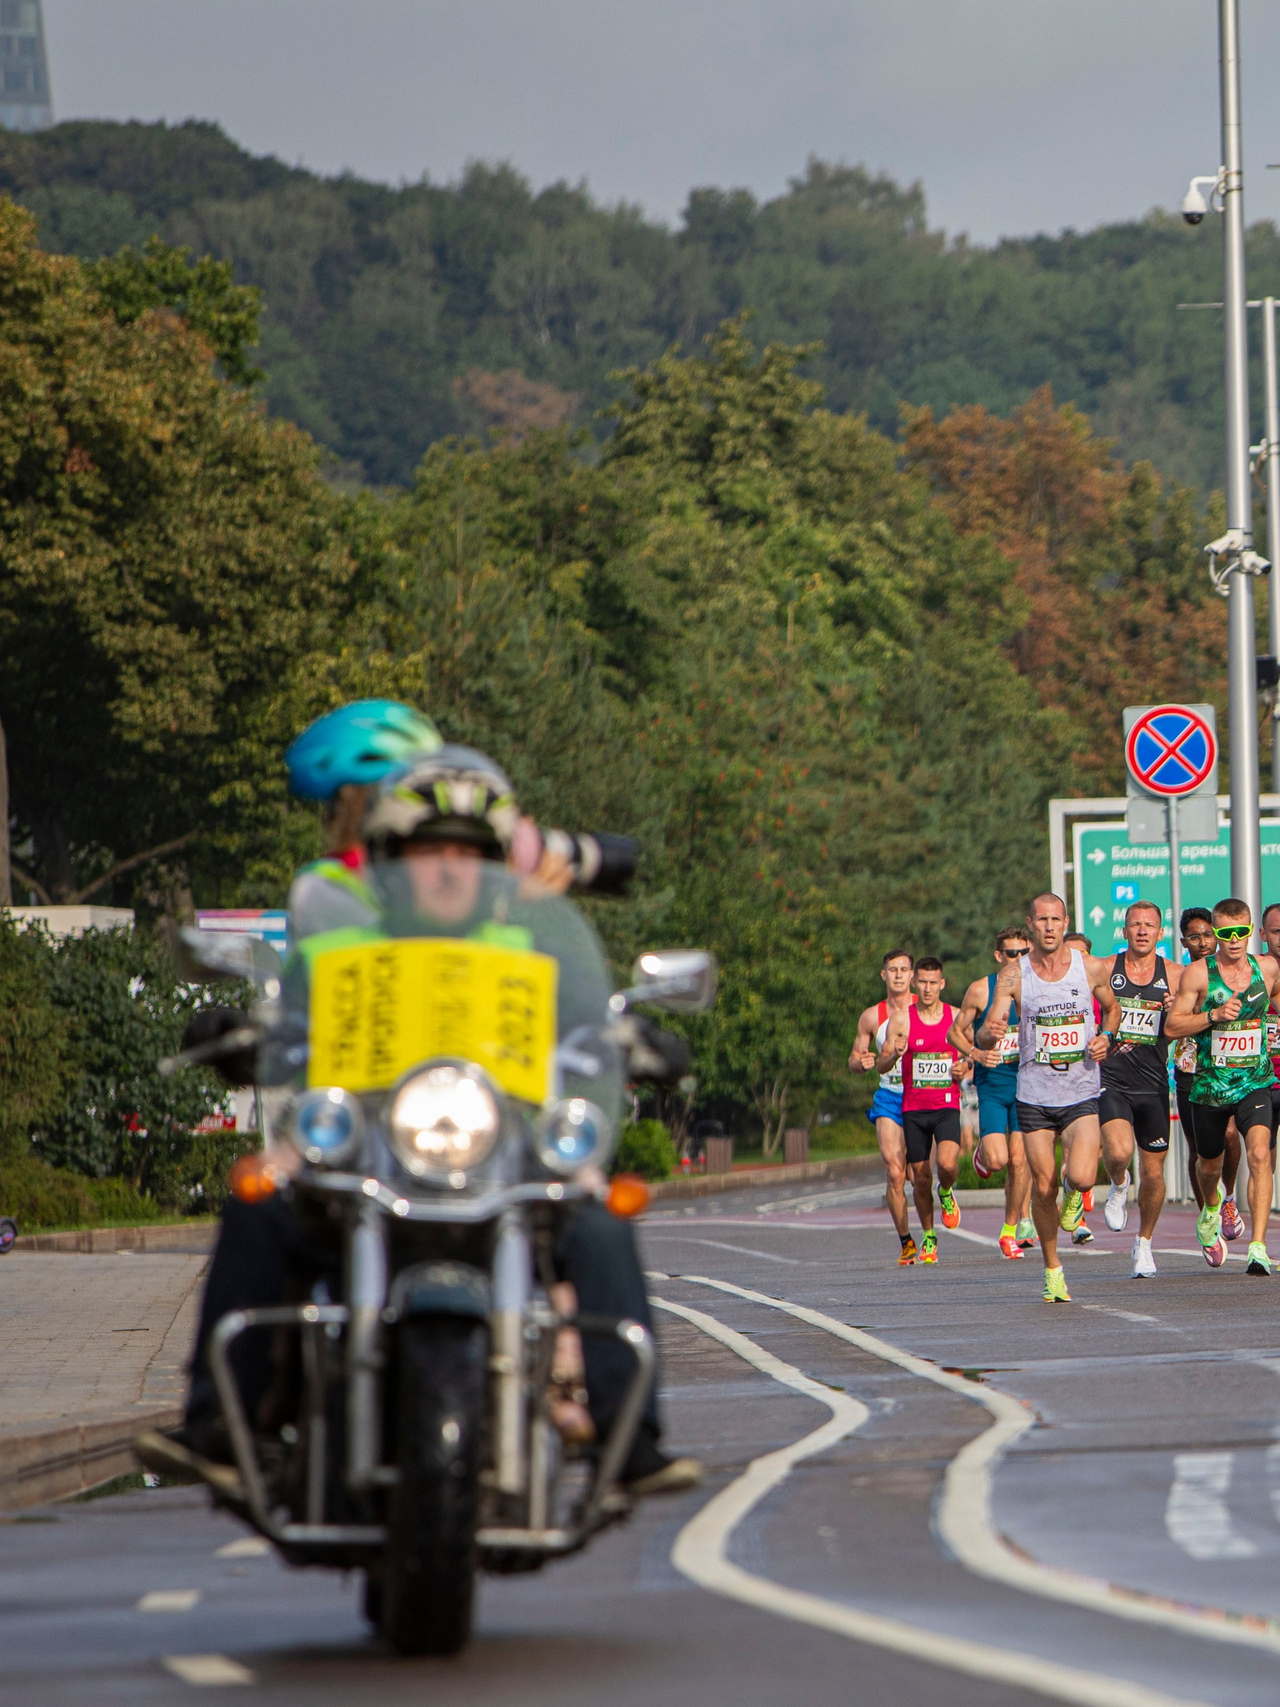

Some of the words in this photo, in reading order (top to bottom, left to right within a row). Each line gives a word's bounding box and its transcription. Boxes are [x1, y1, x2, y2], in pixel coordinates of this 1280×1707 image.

[1111, 845, 1169, 860] Больша
[1181, 844, 1228, 861] арена
[1111, 864, 1166, 879] Bolshaya
[1038, 1002, 1077, 1014] ALTITUDE
[1121, 1010, 1154, 1027] 7174
[1042, 1031, 1079, 1047] 7830
[1219, 1036, 1254, 1051] 7701
[918, 1063, 947, 1074] 5730
